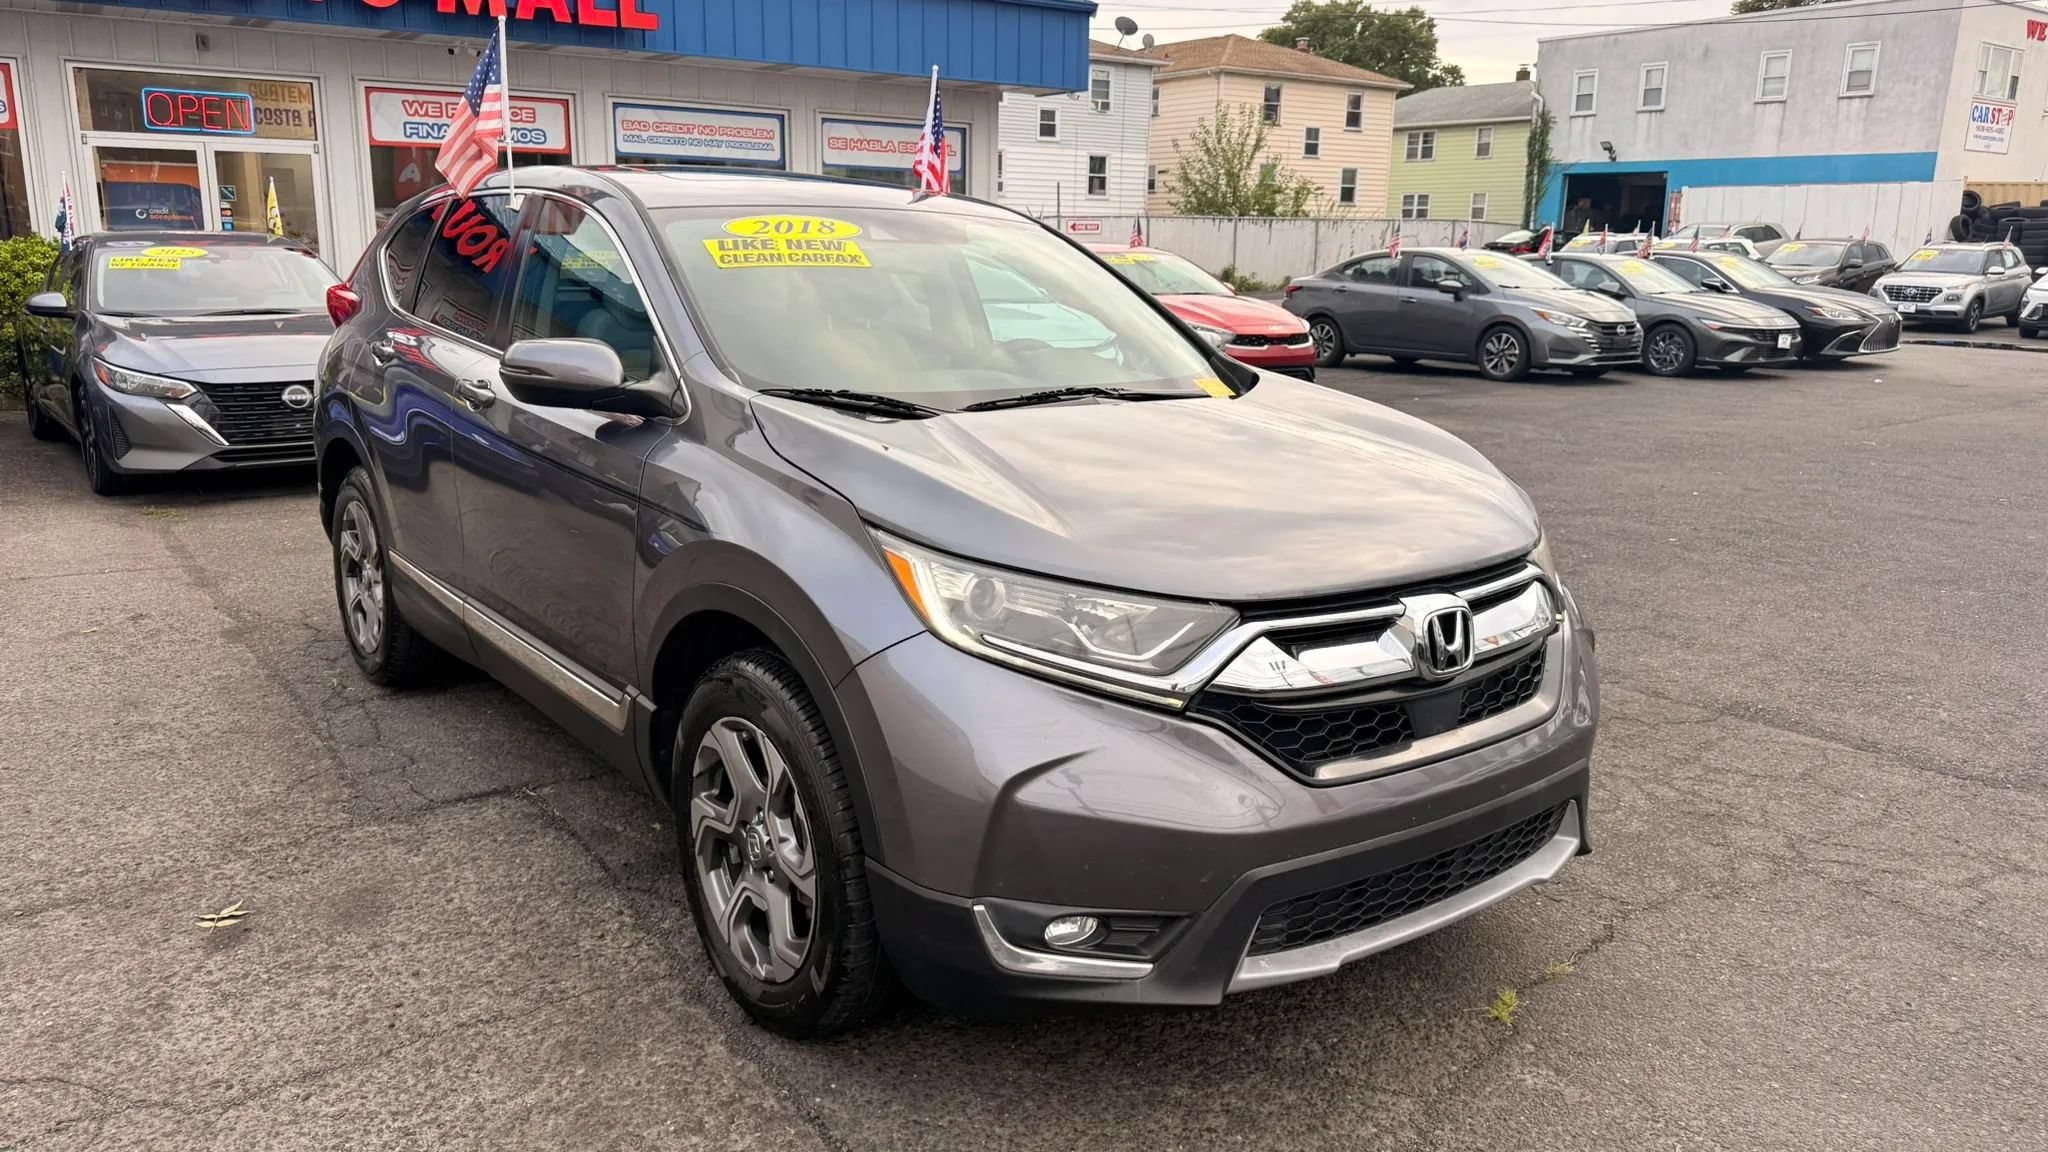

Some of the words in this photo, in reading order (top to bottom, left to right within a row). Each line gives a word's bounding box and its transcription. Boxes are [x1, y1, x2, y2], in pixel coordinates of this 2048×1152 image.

[147, 92, 250, 131] OPEN
[255, 106, 302, 127] COSTA
[401, 99, 443, 118] WE
[1972, 105, 1990, 124] CAR
[403, 121, 547, 145] FINAMOS
[622, 119, 650, 131] BAD
[652, 121, 696, 134] CREDIT
[698, 124, 716, 136] NO
[719, 126, 775, 140] PROBLEM
[623, 134, 646, 144] MAL
[647, 136, 687, 146] CREDITO
[688, 138, 703, 147] NO
[704, 139, 724, 148] HAY
[724, 140, 775, 151] PROBLEMA
[828, 137, 848, 150] SE
[849, 138, 896, 153] HABLA
[149, 207, 169, 215] credit
[752, 219, 836, 235] 2018
[718, 239, 777, 251] LIKE
[785, 239, 844, 251] NEW
[719, 252, 784, 264] CLEAN
[787, 252, 862, 265] CARFAX
